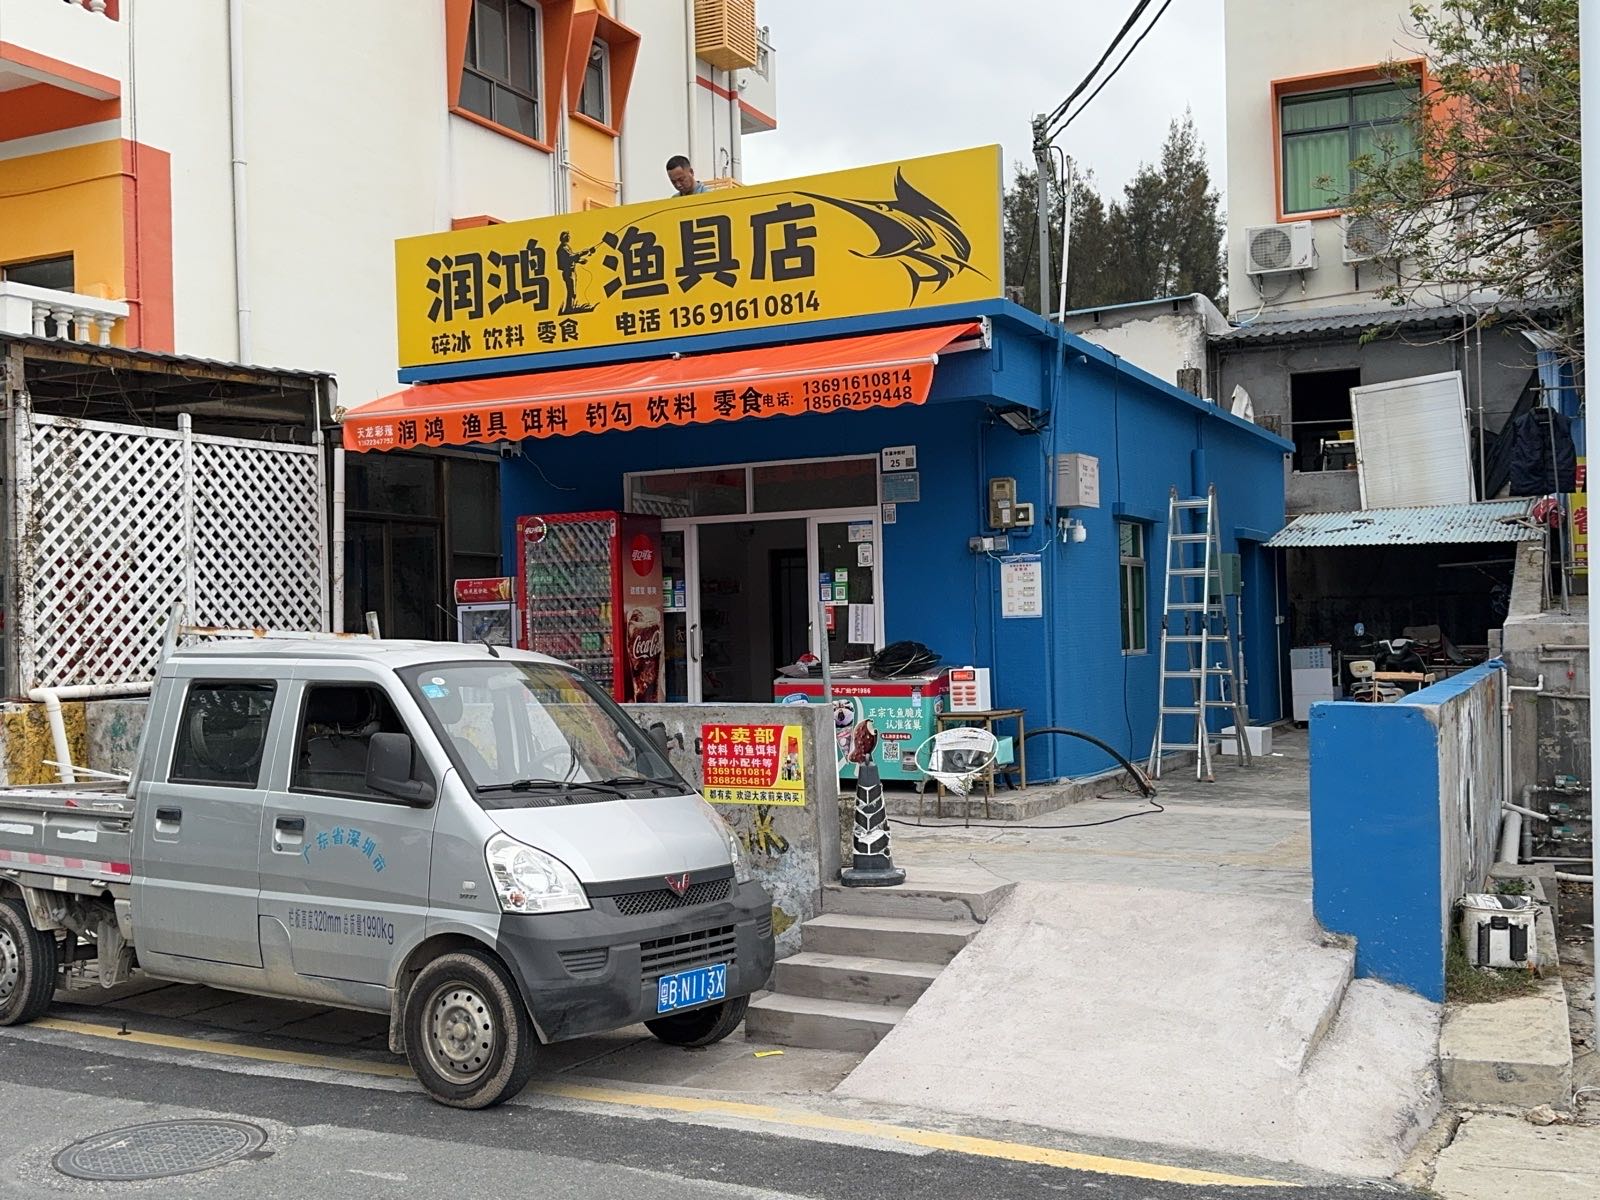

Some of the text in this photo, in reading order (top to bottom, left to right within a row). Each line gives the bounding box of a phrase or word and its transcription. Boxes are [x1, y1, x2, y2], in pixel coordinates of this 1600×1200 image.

[427, 201, 817, 323] 润鸿 渔具店
[616, 308, 661, 336] 电话
[431, 319, 579, 356] 碎冰 饮料 零食
[802, 369, 913, 395] 13691610814
[803, 386, 914, 412] 18566259448
[462, 412, 508, 440] 渔具
[520, 406, 569, 434] 饵料
[585, 400, 633, 428] 钓勾
[647, 394, 698, 423] 饮料
[713, 385, 763, 416] 零食
[890, 459, 901, 468] 25
[867, 707, 924, 719] 正宗飞鱼脆皮
[885, 719, 922, 731] 认准雀巢
[707, 727, 775, 744] 小卖部
[707, 744, 728, 756] 饮料
[734, 744, 777, 757] 钓鱼饵料
[707, 758, 773, 768] 各种小配件等
[707, 767, 772, 776] 13691610814
[707, 776, 772, 786] 13682654811
[710, 790, 732, 800] 都有卖
[303, 827, 386, 872] 广东省深圳市
